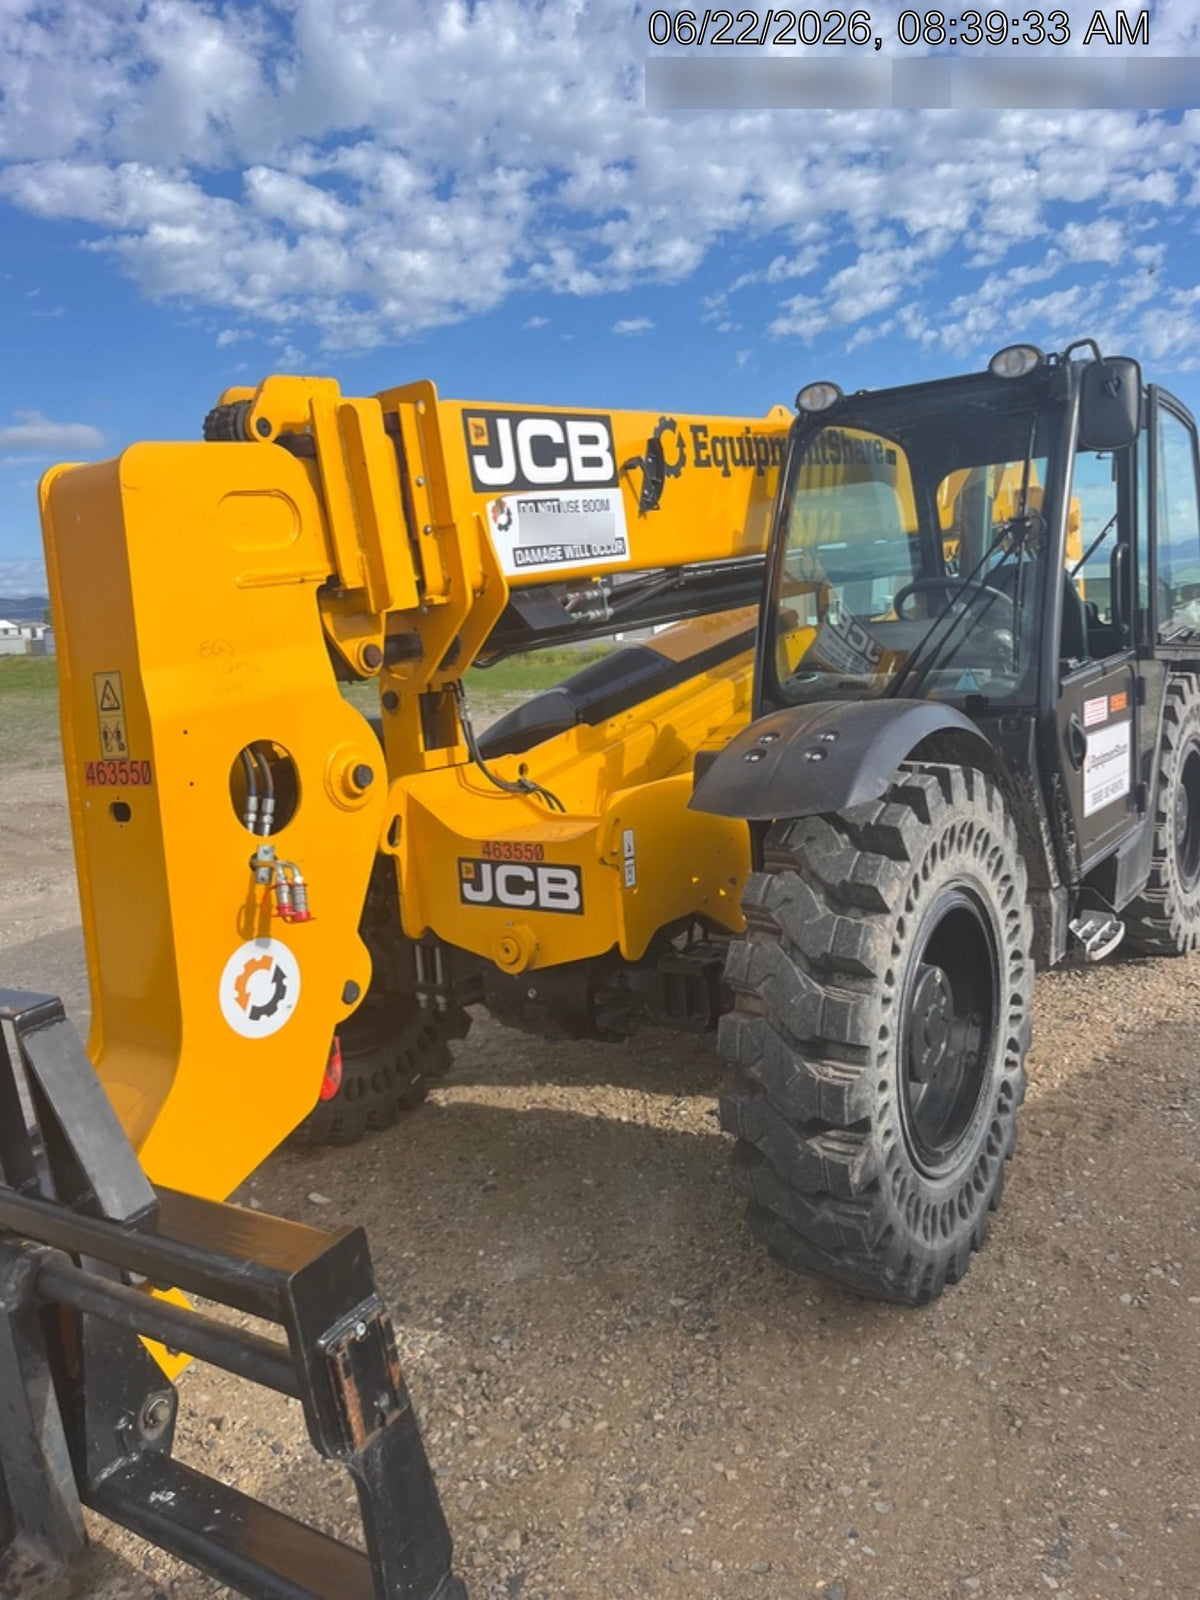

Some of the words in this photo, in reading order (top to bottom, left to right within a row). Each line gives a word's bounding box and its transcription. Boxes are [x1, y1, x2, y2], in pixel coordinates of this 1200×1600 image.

[473, 417, 615, 486] JCB
[690, 424, 884, 477] EquipmntShare
[538, 500, 560, 513] NOT
[561, 499, 580, 513] USE
[582, 498, 610, 512] BOOM
[515, 546, 563, 565] DAMAGE
[564, 544, 591, 559] WILL
[591, 540, 625, 556] OCCUR
[86, 761, 152, 785] 463550
[482, 841, 545, 862] 463550
[462, 863, 581, 910] JCB
